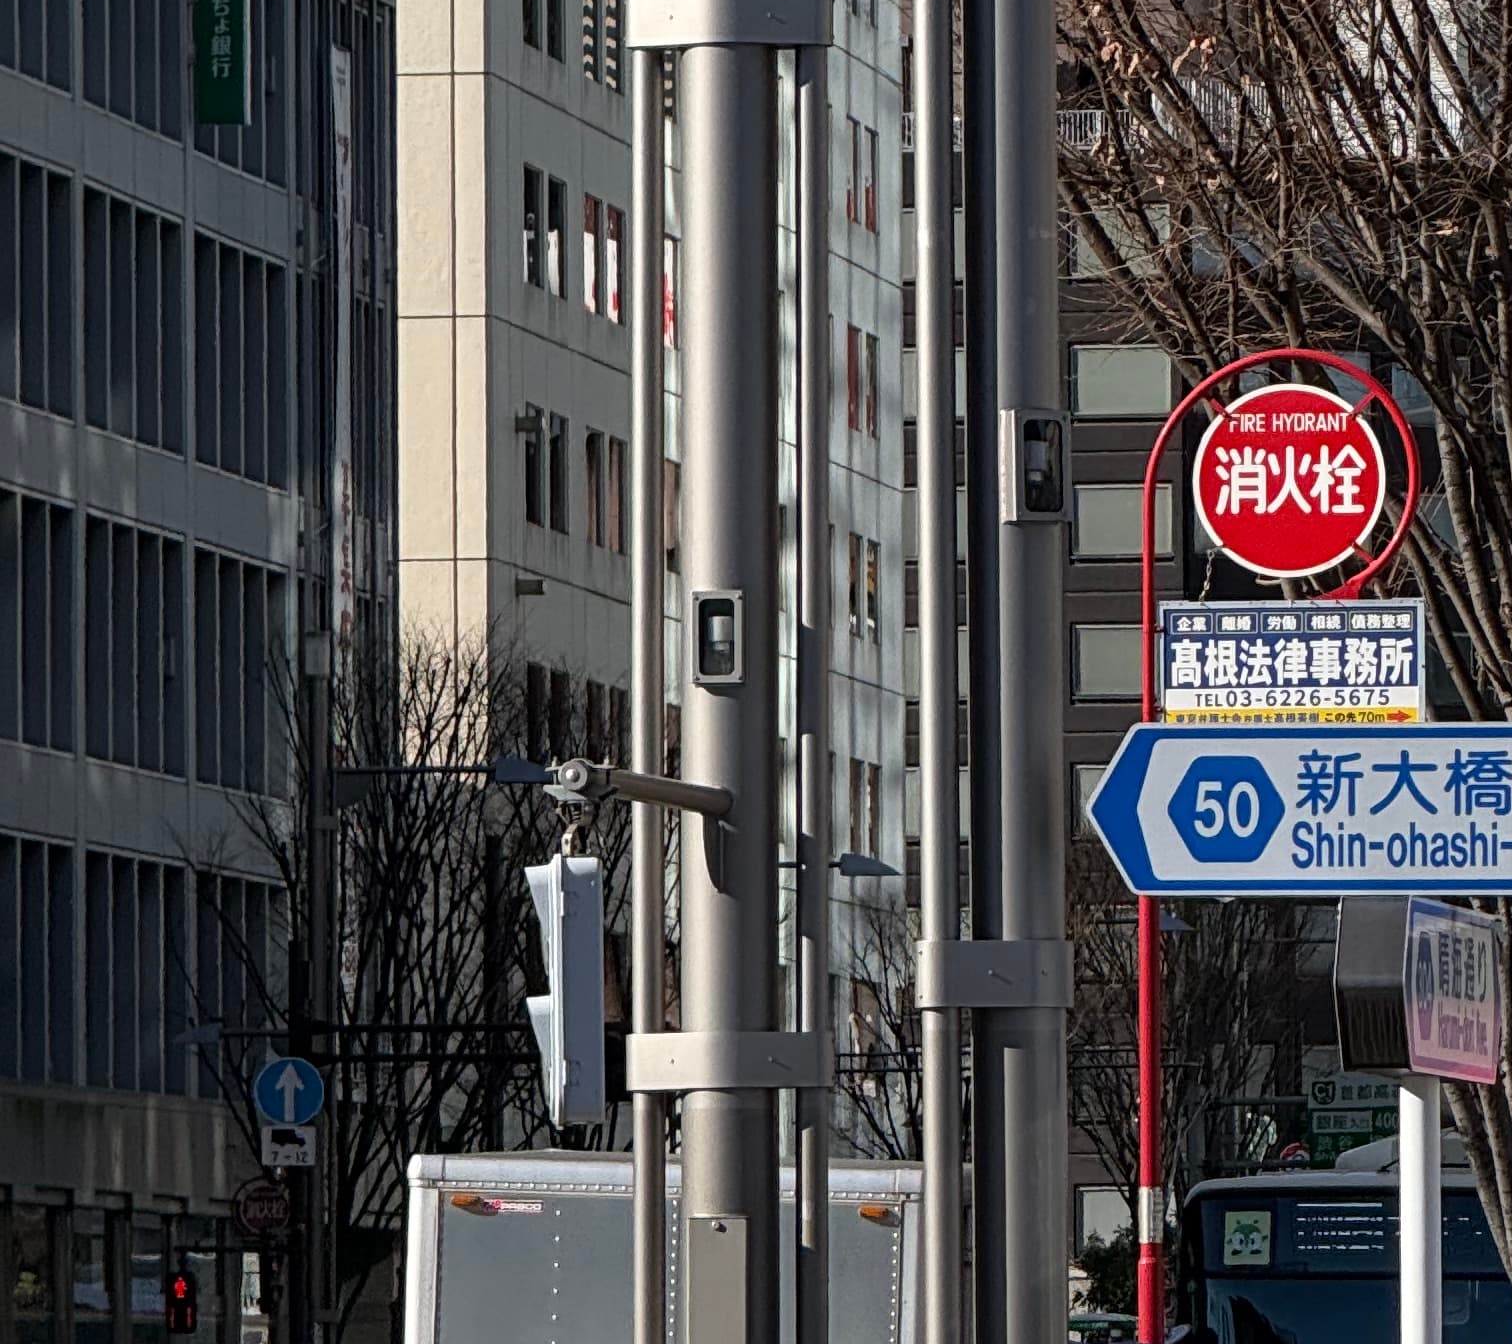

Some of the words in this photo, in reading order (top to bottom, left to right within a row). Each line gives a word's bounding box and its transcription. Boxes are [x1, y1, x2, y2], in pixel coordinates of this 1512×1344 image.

[1229, 413, 1266, 432] FIRE
[1272, 412, 1349, 432] HYDRANT
[1215, 444, 1368, 514] 消火栓
[1177, 616, 1207, 631] 企業
[1221, 616, 1251, 631] 離婚
[1267, 615, 1297, 631] 労働
[1310, 615, 1341, 630] 相続
[1351, 613, 1411, 630] 債務整理
[1193, 781, 1260, 838] 50
